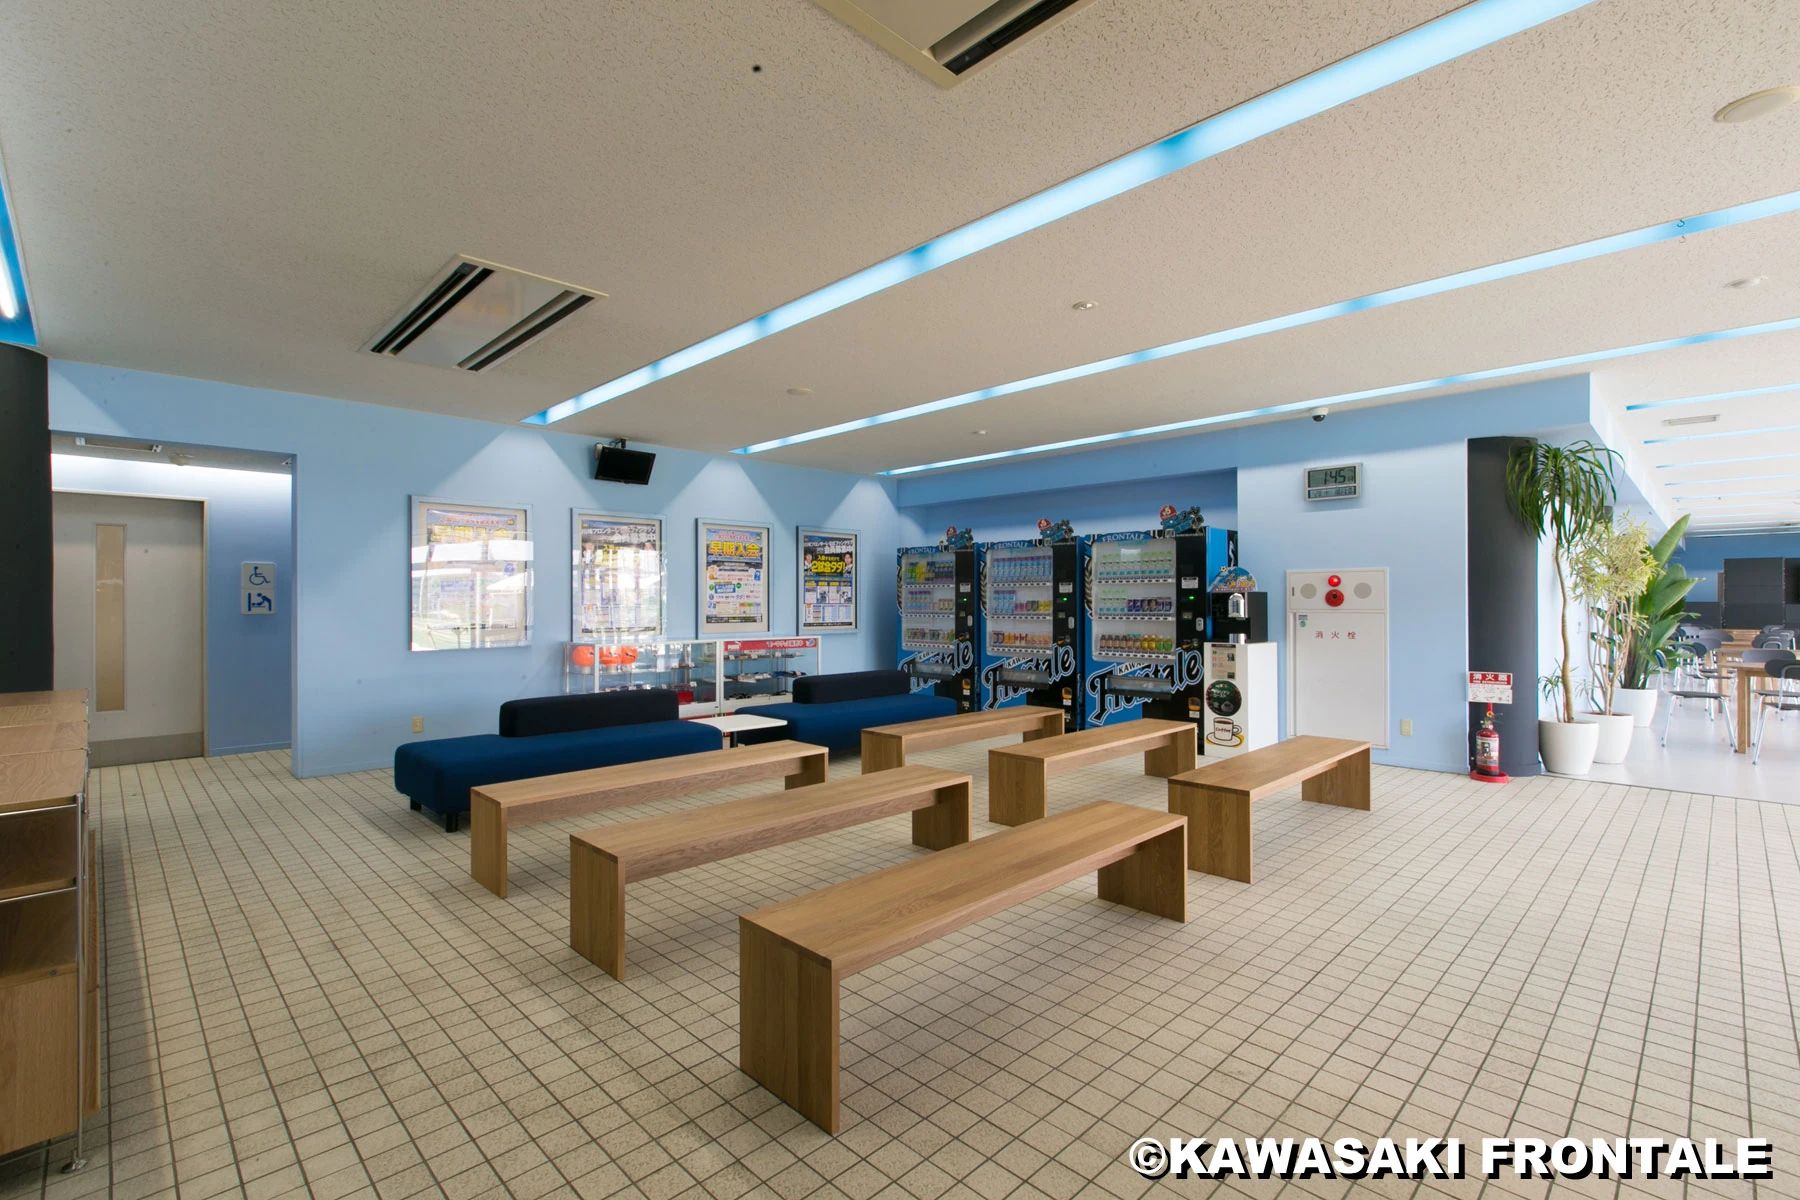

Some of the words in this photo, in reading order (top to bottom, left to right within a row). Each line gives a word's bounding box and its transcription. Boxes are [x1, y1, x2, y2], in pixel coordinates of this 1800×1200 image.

[1102, 533, 1145, 542] FRONTALE
[995, 541, 1028, 549] FRONTALE
[1315, 631, 1356, 640] 消火栓
